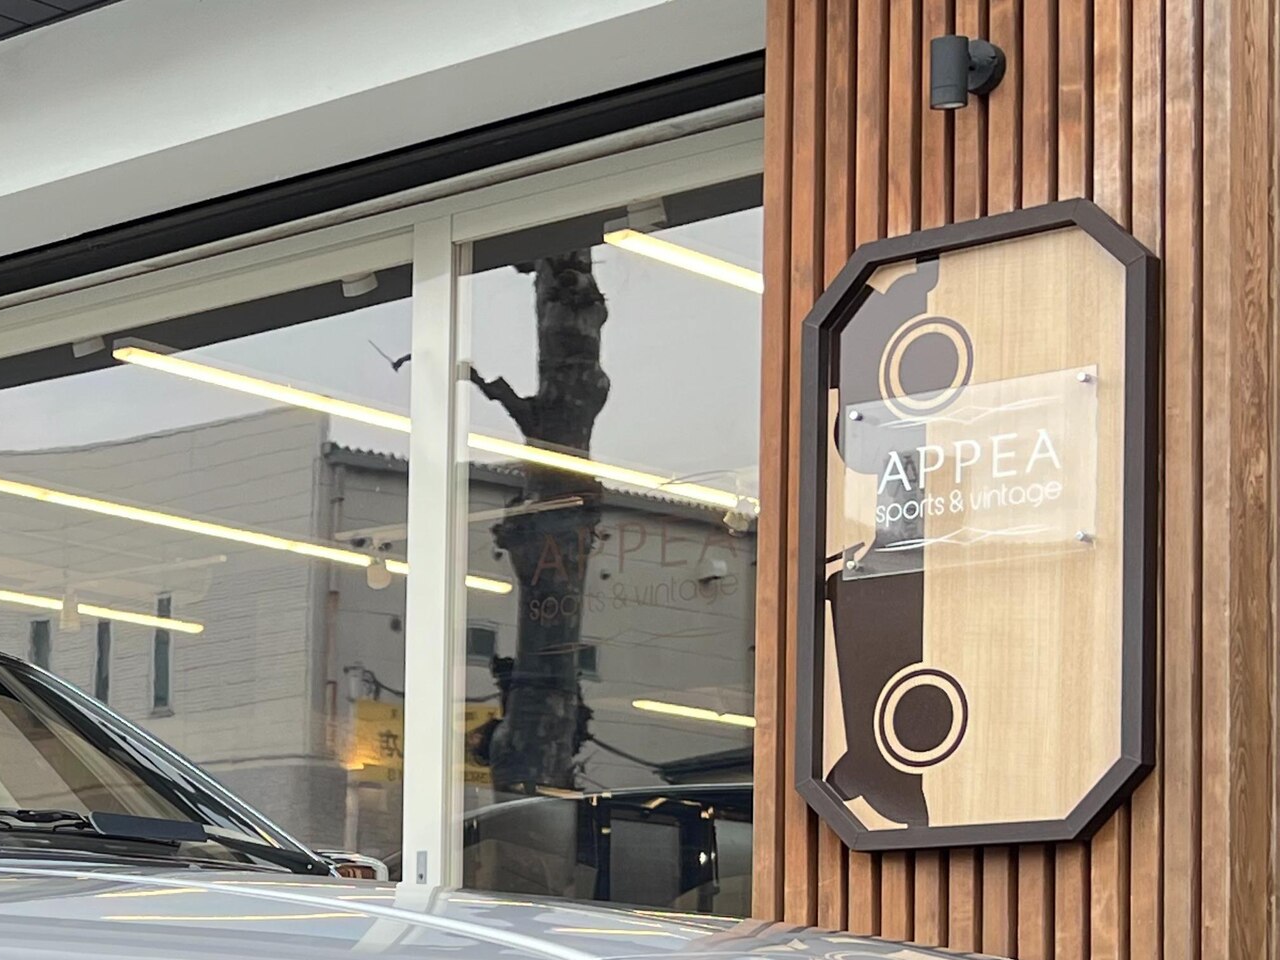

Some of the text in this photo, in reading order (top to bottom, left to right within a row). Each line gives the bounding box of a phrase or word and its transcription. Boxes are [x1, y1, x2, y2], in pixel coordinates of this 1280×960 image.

[876, 428, 1063, 495] APPEA
[875, 480, 1063, 528] sports & vintage
